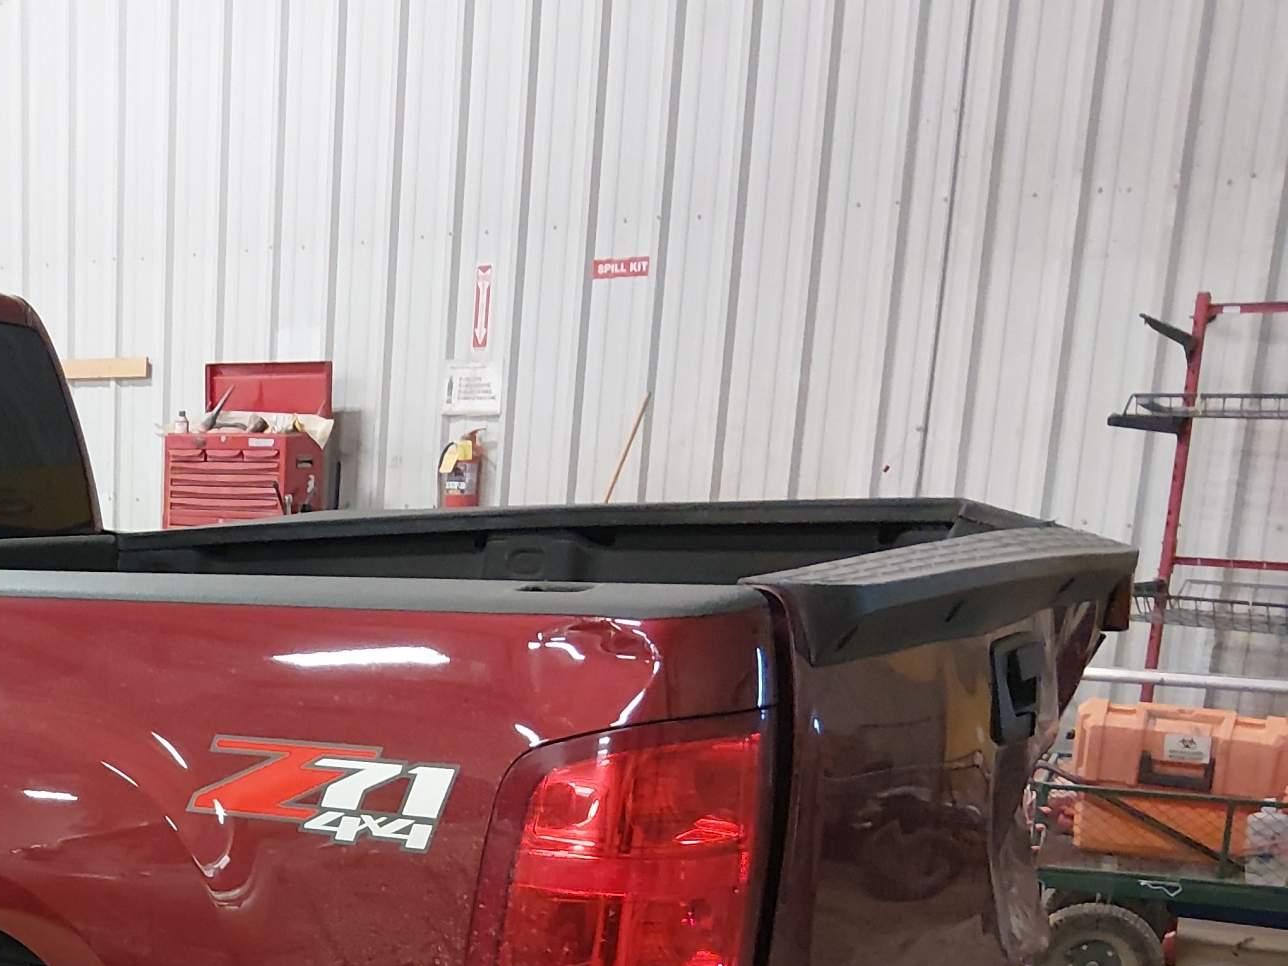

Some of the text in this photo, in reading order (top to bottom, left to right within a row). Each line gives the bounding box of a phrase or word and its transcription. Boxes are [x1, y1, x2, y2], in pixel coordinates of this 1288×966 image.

[597, 260, 648, 275] SPILL KIT
[186, 734, 460, 826] Z71
